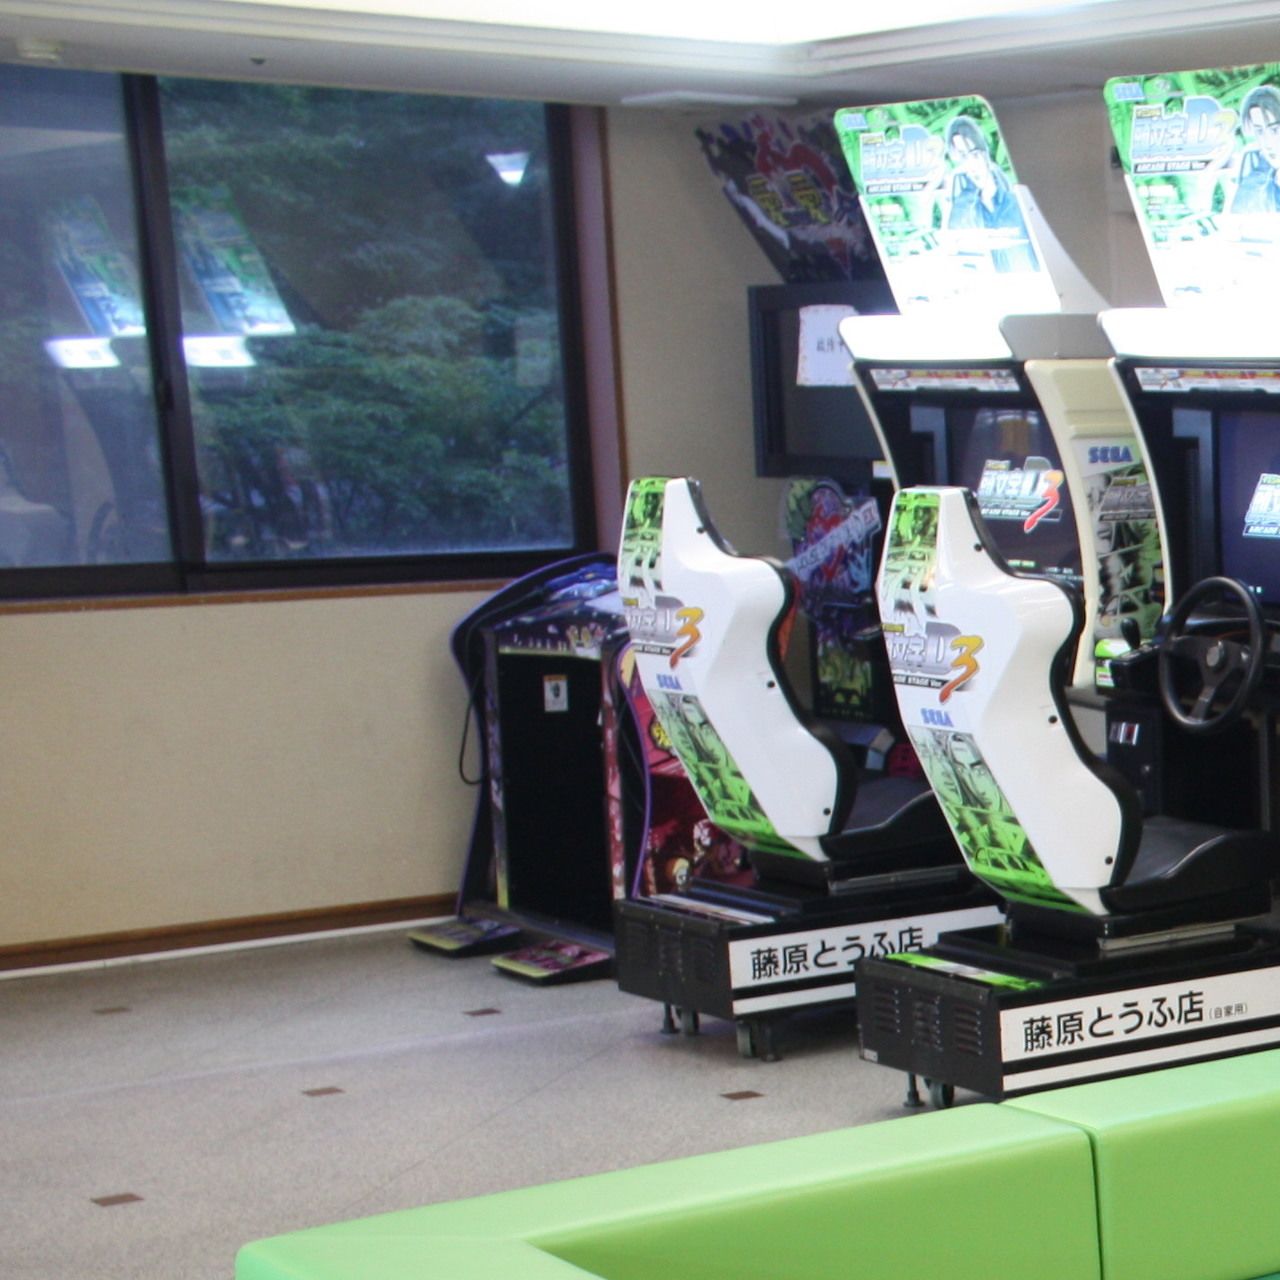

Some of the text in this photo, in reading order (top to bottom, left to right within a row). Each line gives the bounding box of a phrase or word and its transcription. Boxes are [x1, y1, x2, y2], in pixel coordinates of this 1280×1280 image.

[1088, 446, 1134, 464] SEGA
[750, 927, 924, 981] 藤原とうふ店
[1022, 990, 1204, 1053] 藤原とうふ店
